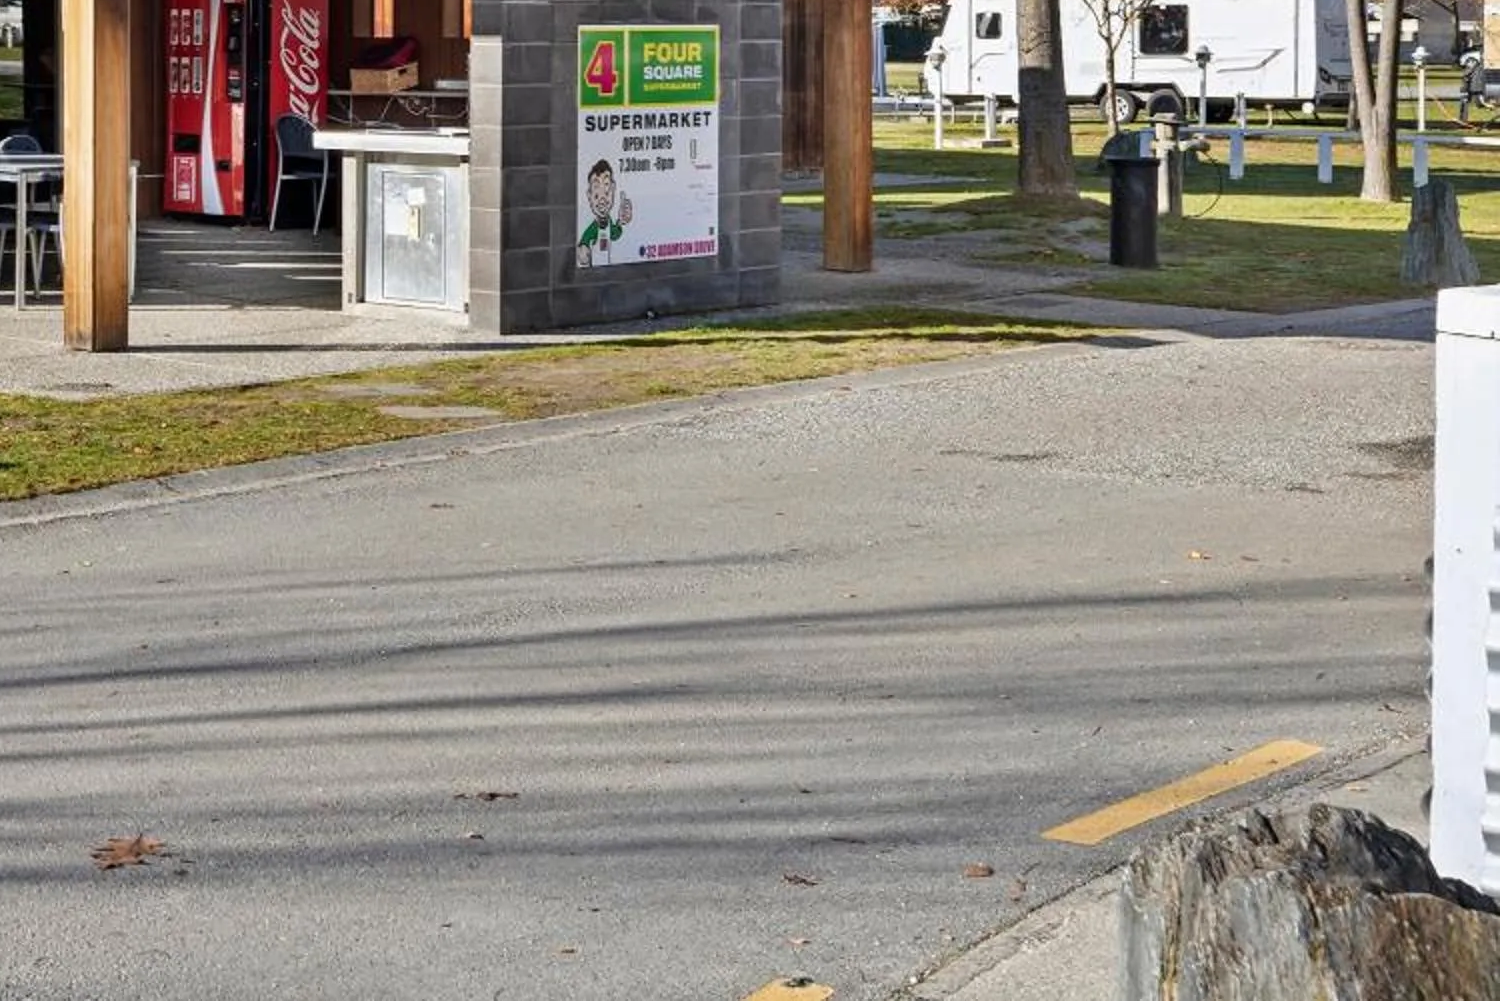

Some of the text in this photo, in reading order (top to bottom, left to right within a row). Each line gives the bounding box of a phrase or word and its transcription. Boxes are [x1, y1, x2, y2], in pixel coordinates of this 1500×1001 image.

[643, 42, 702, 63] FOUR
[584, 40, 618, 96] 4
[643, 65, 703, 80] SQUARE
[585, 111, 712, 132] SUPERMARKET
[622, 134, 673, 152] OPEN 7 DAYS
